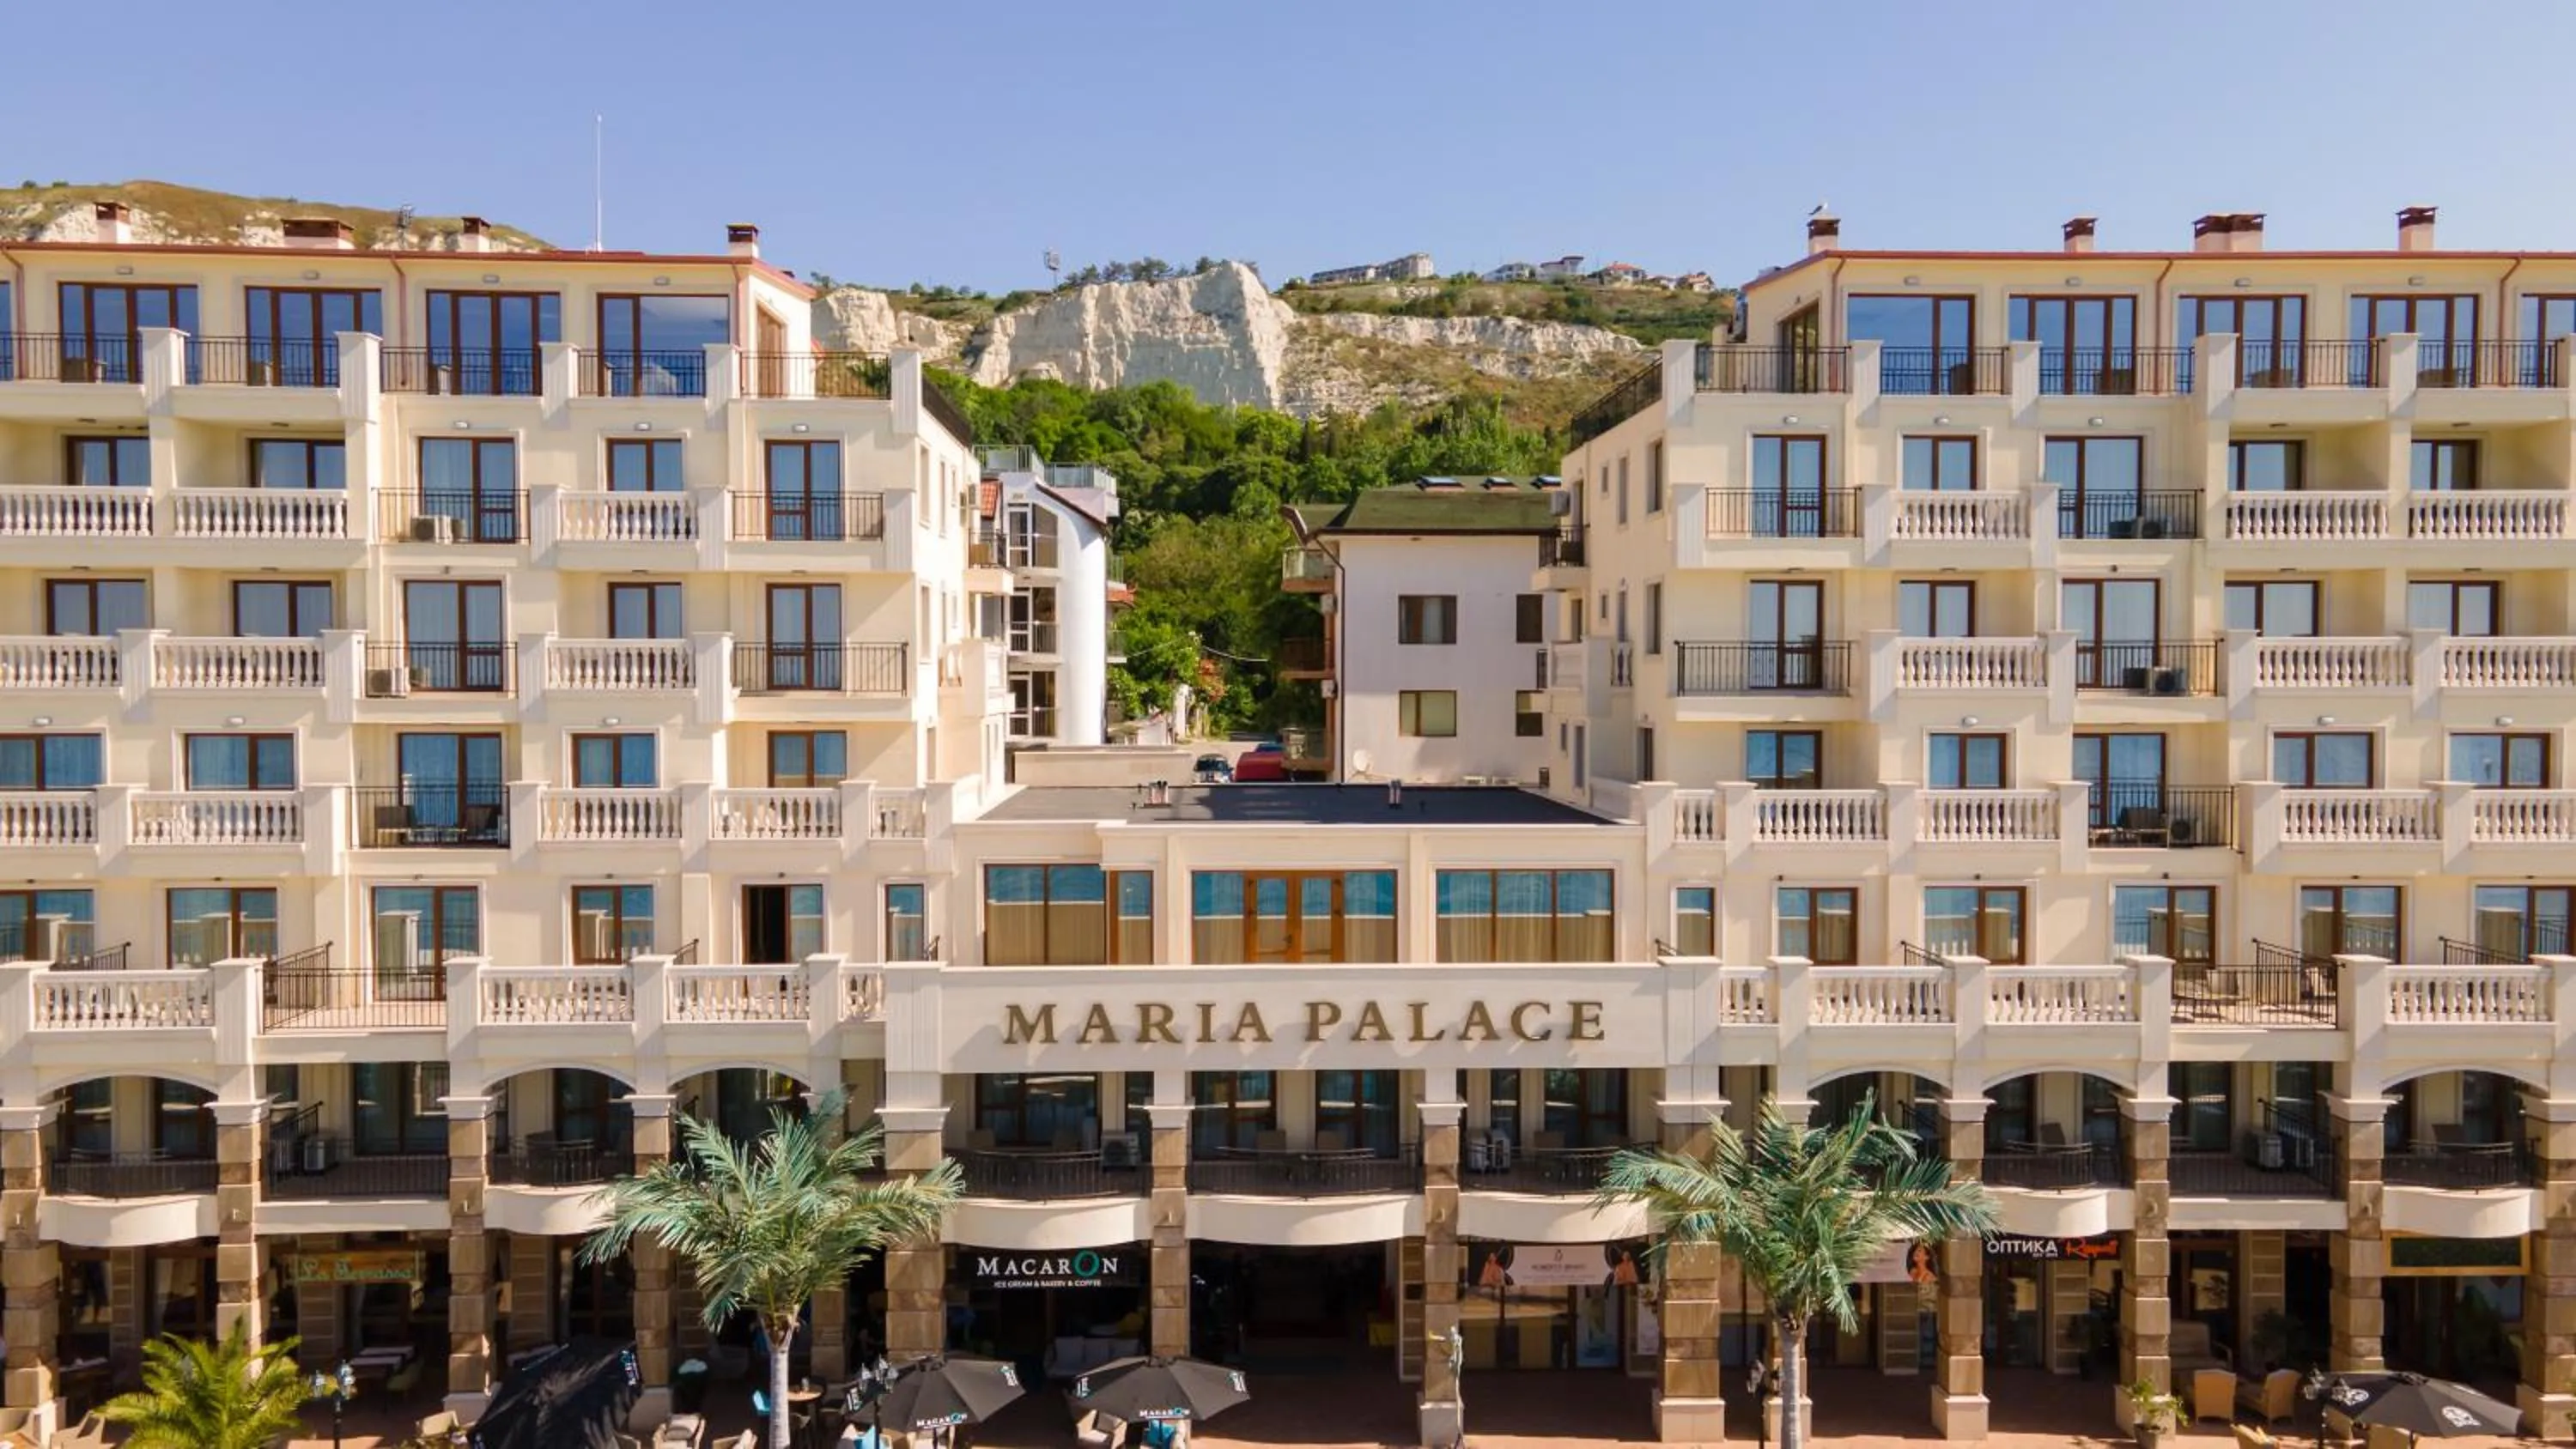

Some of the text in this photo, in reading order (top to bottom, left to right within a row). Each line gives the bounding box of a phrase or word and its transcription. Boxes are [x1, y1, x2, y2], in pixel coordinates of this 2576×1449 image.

[1003, 1001, 1606, 1046] MARIA PALACE
[1986, 1240, 2058, 1254] ОПТИКА
[976, 1250, 1118, 1277] MACARON
[1008, 1279, 1032, 1288] CREAM
[1074, 1278, 1102, 1287] COFFEE
